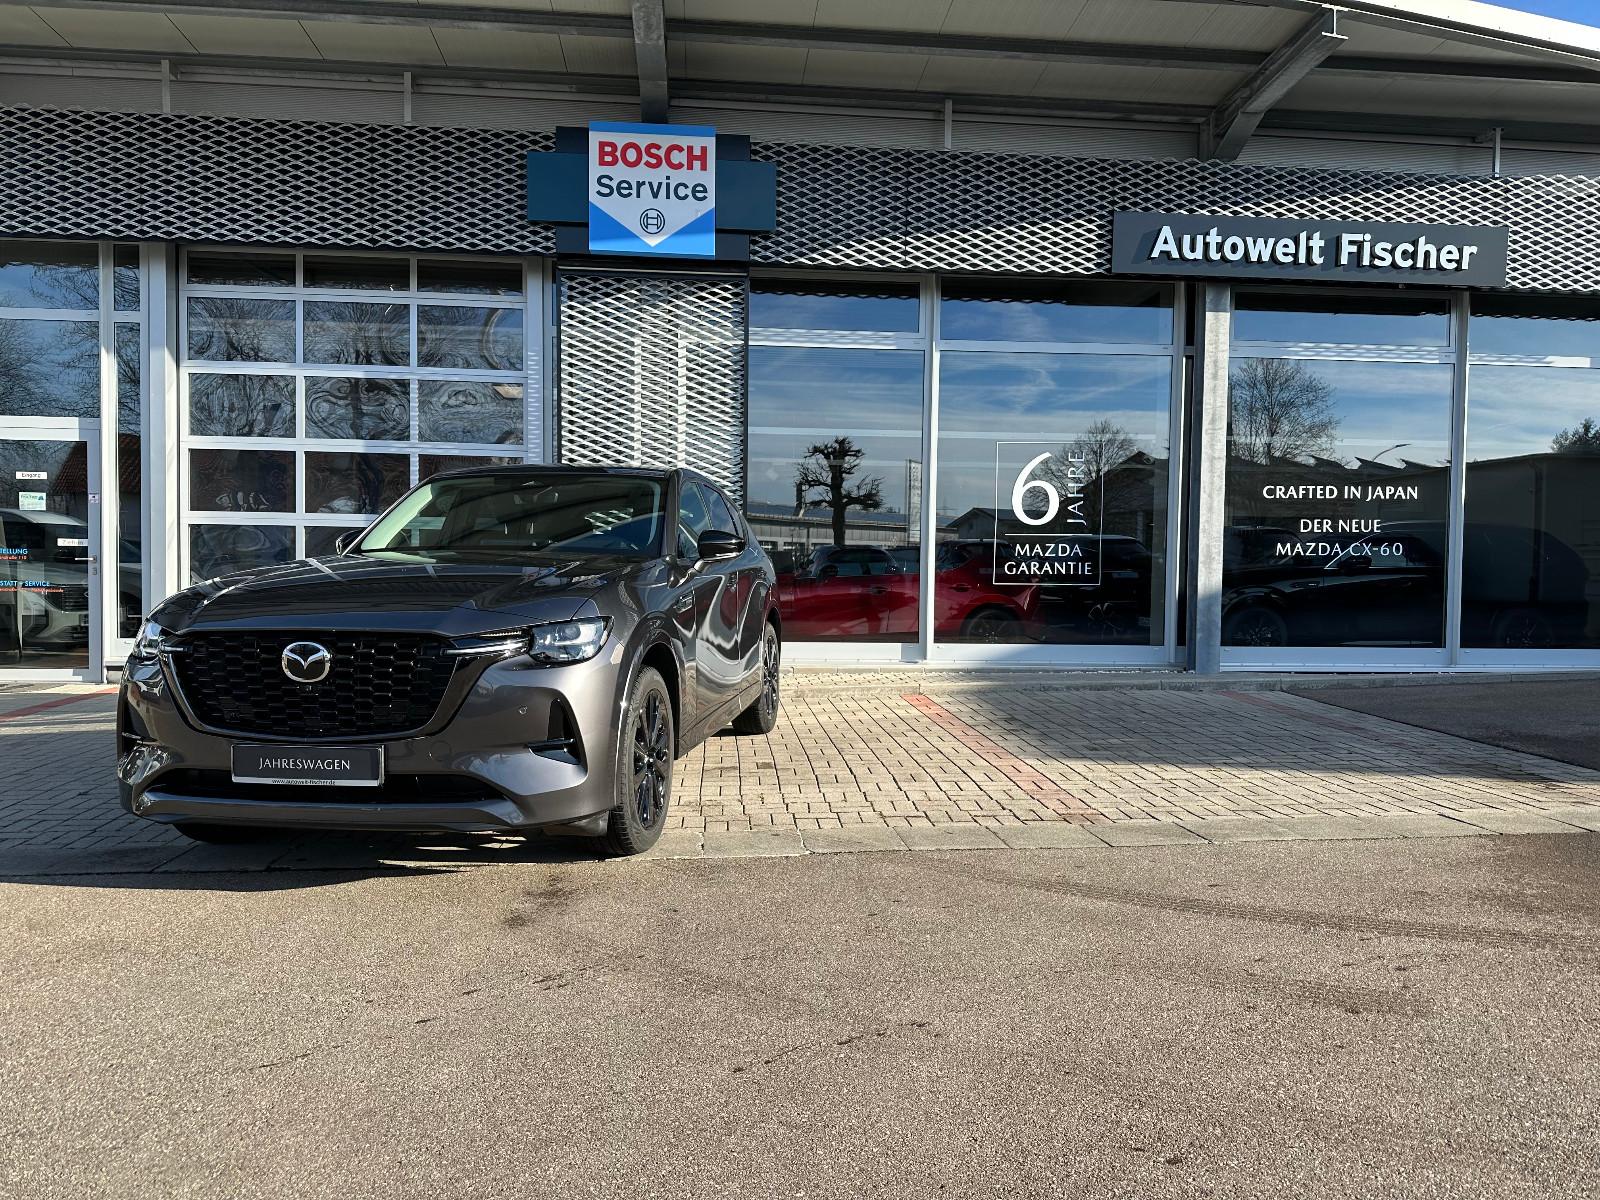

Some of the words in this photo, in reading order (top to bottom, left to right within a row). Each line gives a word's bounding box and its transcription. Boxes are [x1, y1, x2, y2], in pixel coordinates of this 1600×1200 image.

[598, 141, 708, 171] BOSCH
[596, 174, 708, 202] Service
[1150, 225, 1326, 266] Autowelt
[1338, 231, 1478, 271] Fischer
[1012, 451, 1060, 526] 6
[1066, 451, 1087, 526] JAHRE
[1262, 485, 1338, 500] CRAFTED
[1344, 485, 1361, 500] IN
[1365, 485, 1419, 502] JAPAN
[1299, 519, 1334, 533] DER
[1338, 519, 1382, 533] NEUE
[1015, 543, 1083, 557] MAZDA
[1276, 542, 1343, 556] MAZDA
[1349, 542, 1403, 556] CX-60
[1004, 561, 1093, 575] GARANTIE
[258, 757, 350, 771] JAHRESWAGEN
